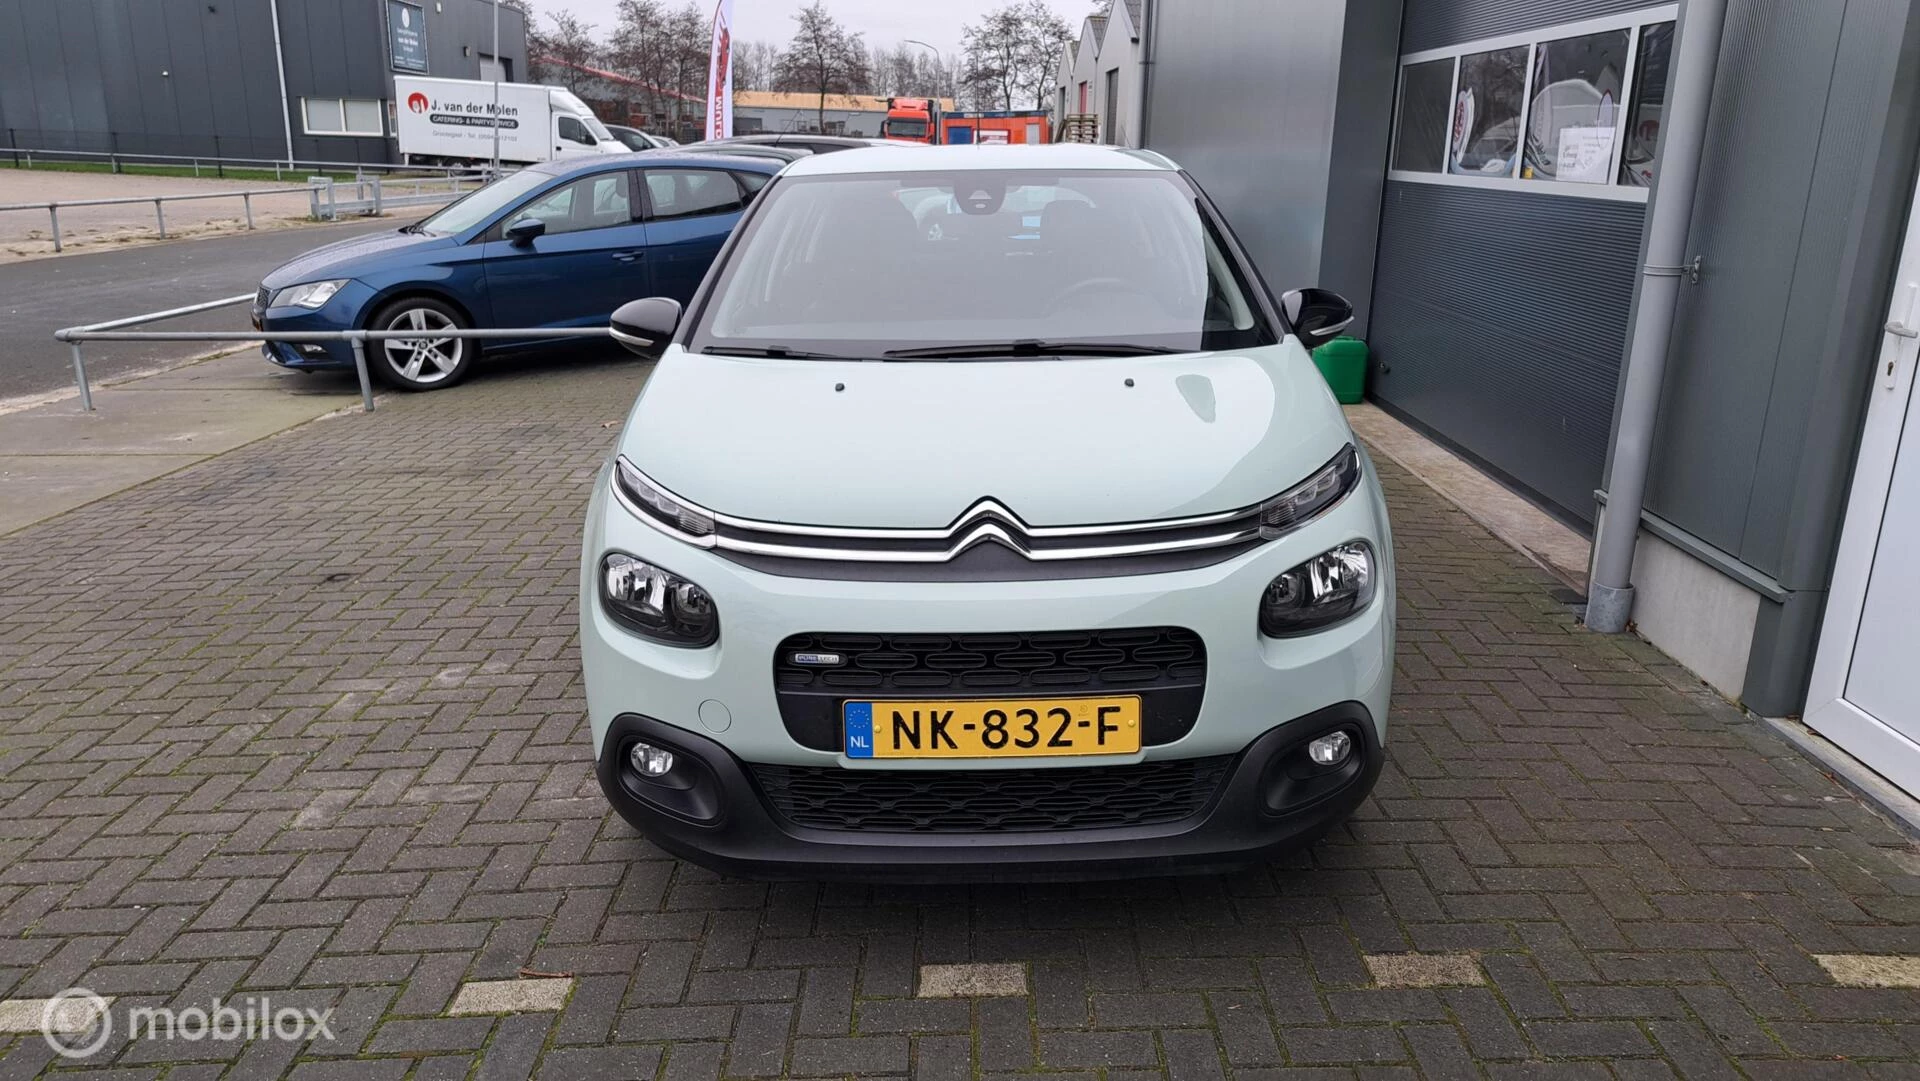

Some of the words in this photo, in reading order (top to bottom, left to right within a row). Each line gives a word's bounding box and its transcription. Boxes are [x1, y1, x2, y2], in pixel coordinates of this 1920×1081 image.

[431, 99, 441, 111] J.
[444, 103, 463, 112] van
[466, 102, 483, 114] der
[486, 103, 518, 116] Molen
[892, 705, 1121, 750] NK-832-F
[850, 736, 870, 749] NL
